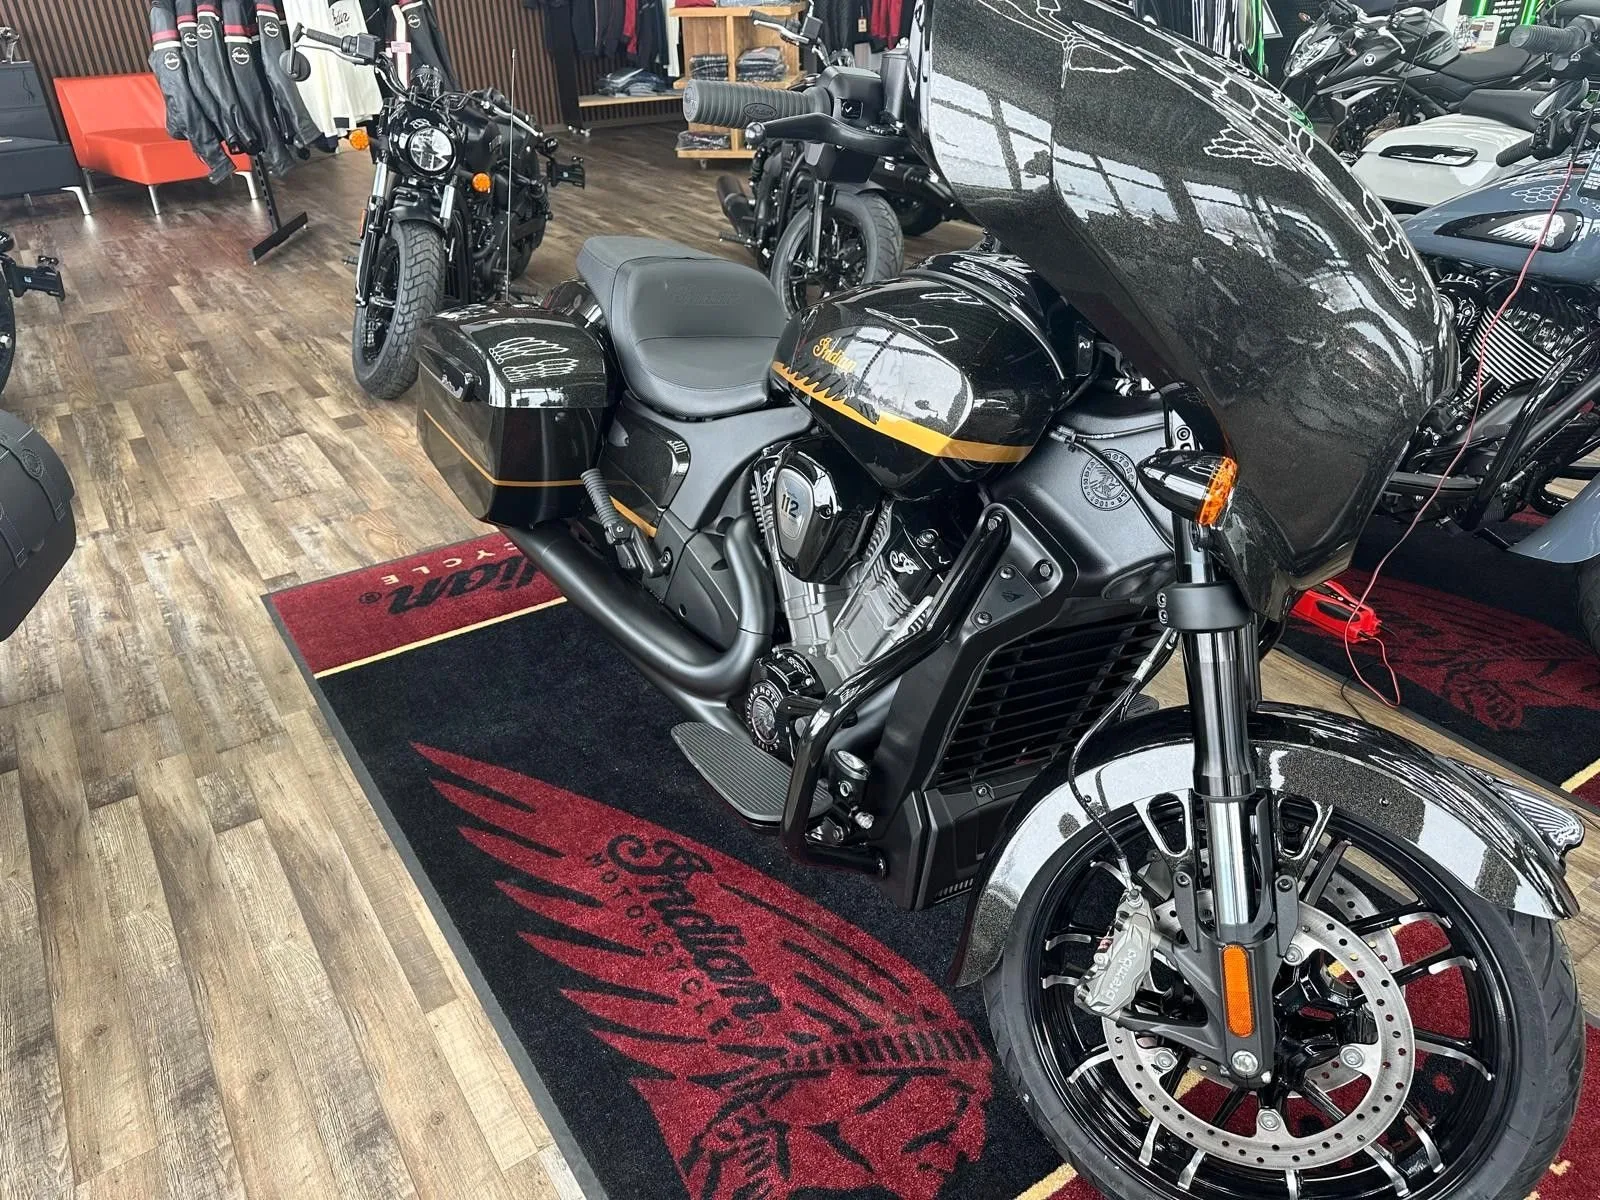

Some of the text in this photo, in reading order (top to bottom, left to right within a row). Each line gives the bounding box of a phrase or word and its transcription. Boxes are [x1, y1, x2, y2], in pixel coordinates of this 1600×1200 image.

[812, 337, 857, 373] Indian
[781, 493, 799, 519] 112
[584, 851, 732, 1035] MOTORCYCLE
[1100, 948, 1138, 1002] brembo
